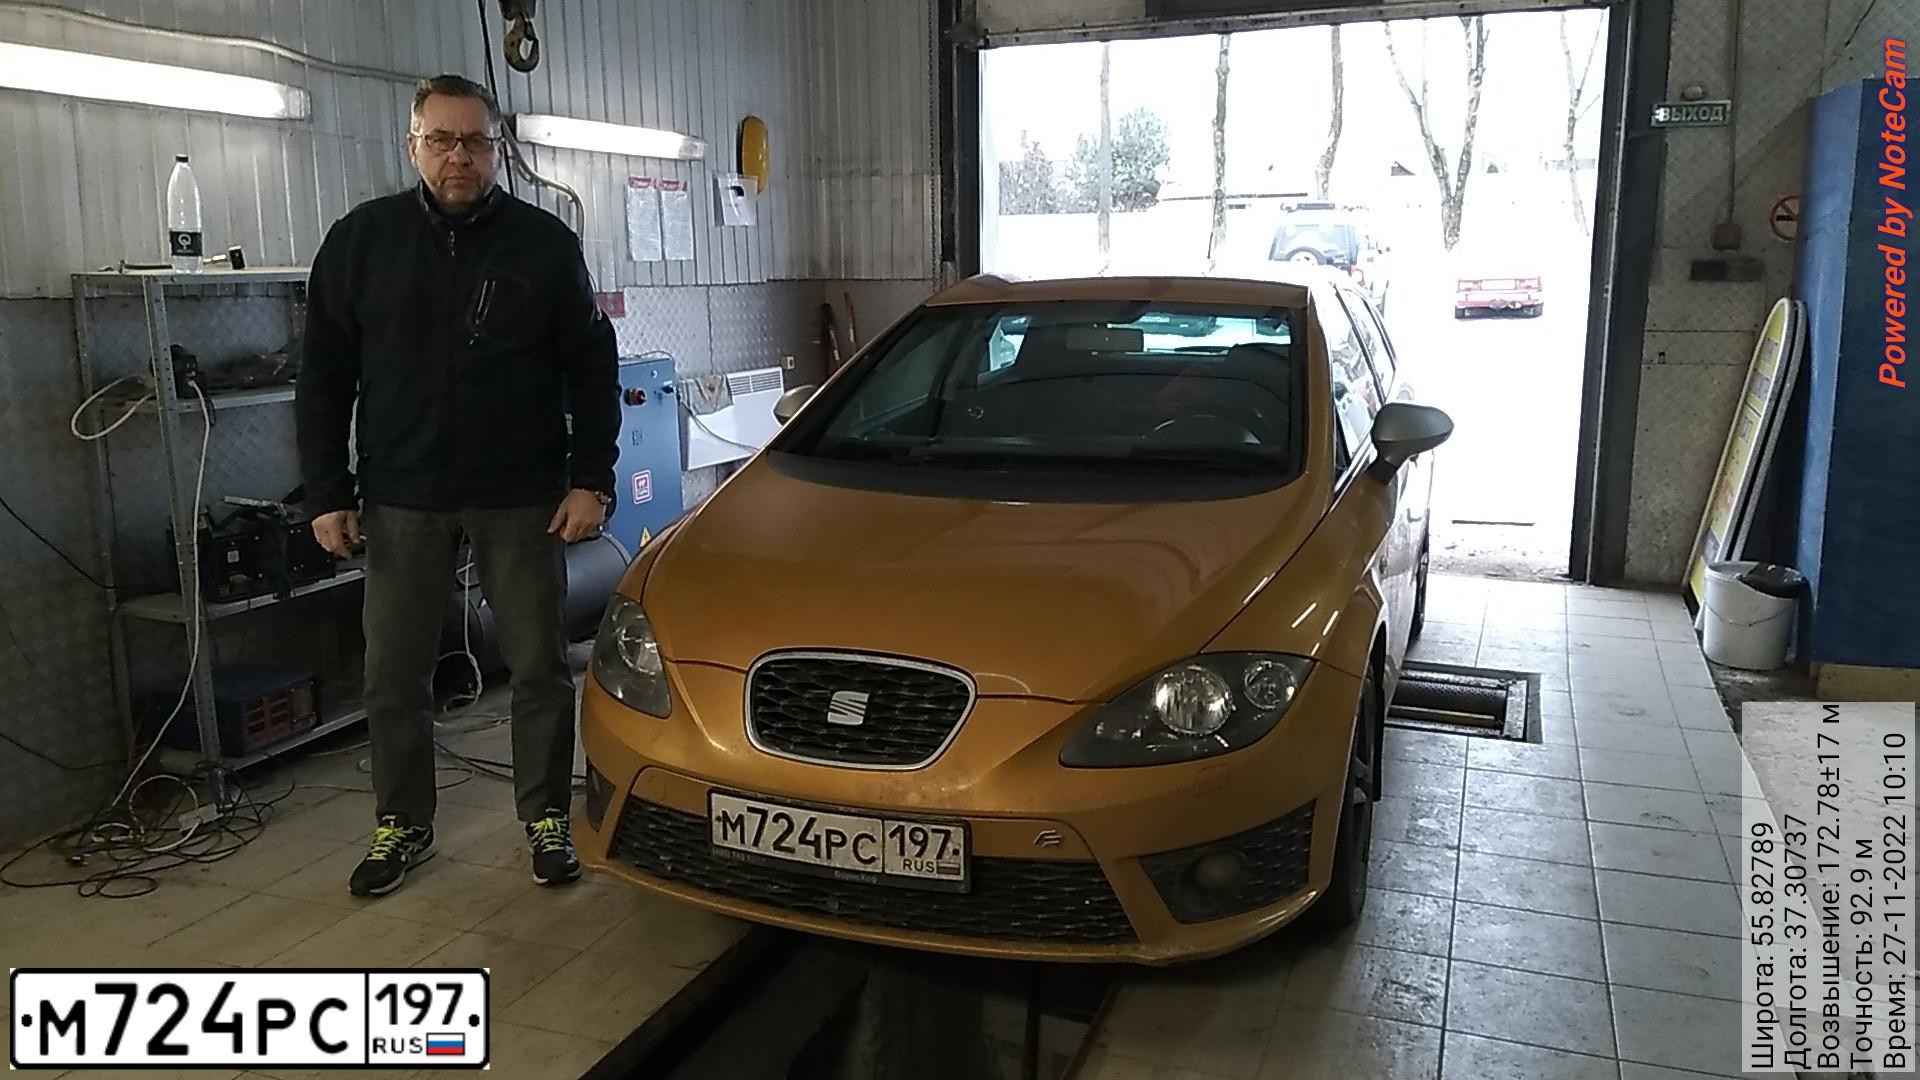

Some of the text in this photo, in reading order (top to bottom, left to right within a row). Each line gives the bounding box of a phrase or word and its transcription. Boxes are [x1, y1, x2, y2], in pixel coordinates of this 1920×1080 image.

[1659, 105, 1724, 122] ВЫХОД
[888, 824, 952, 860] 197
[902, 859, 935, 874] RUS
